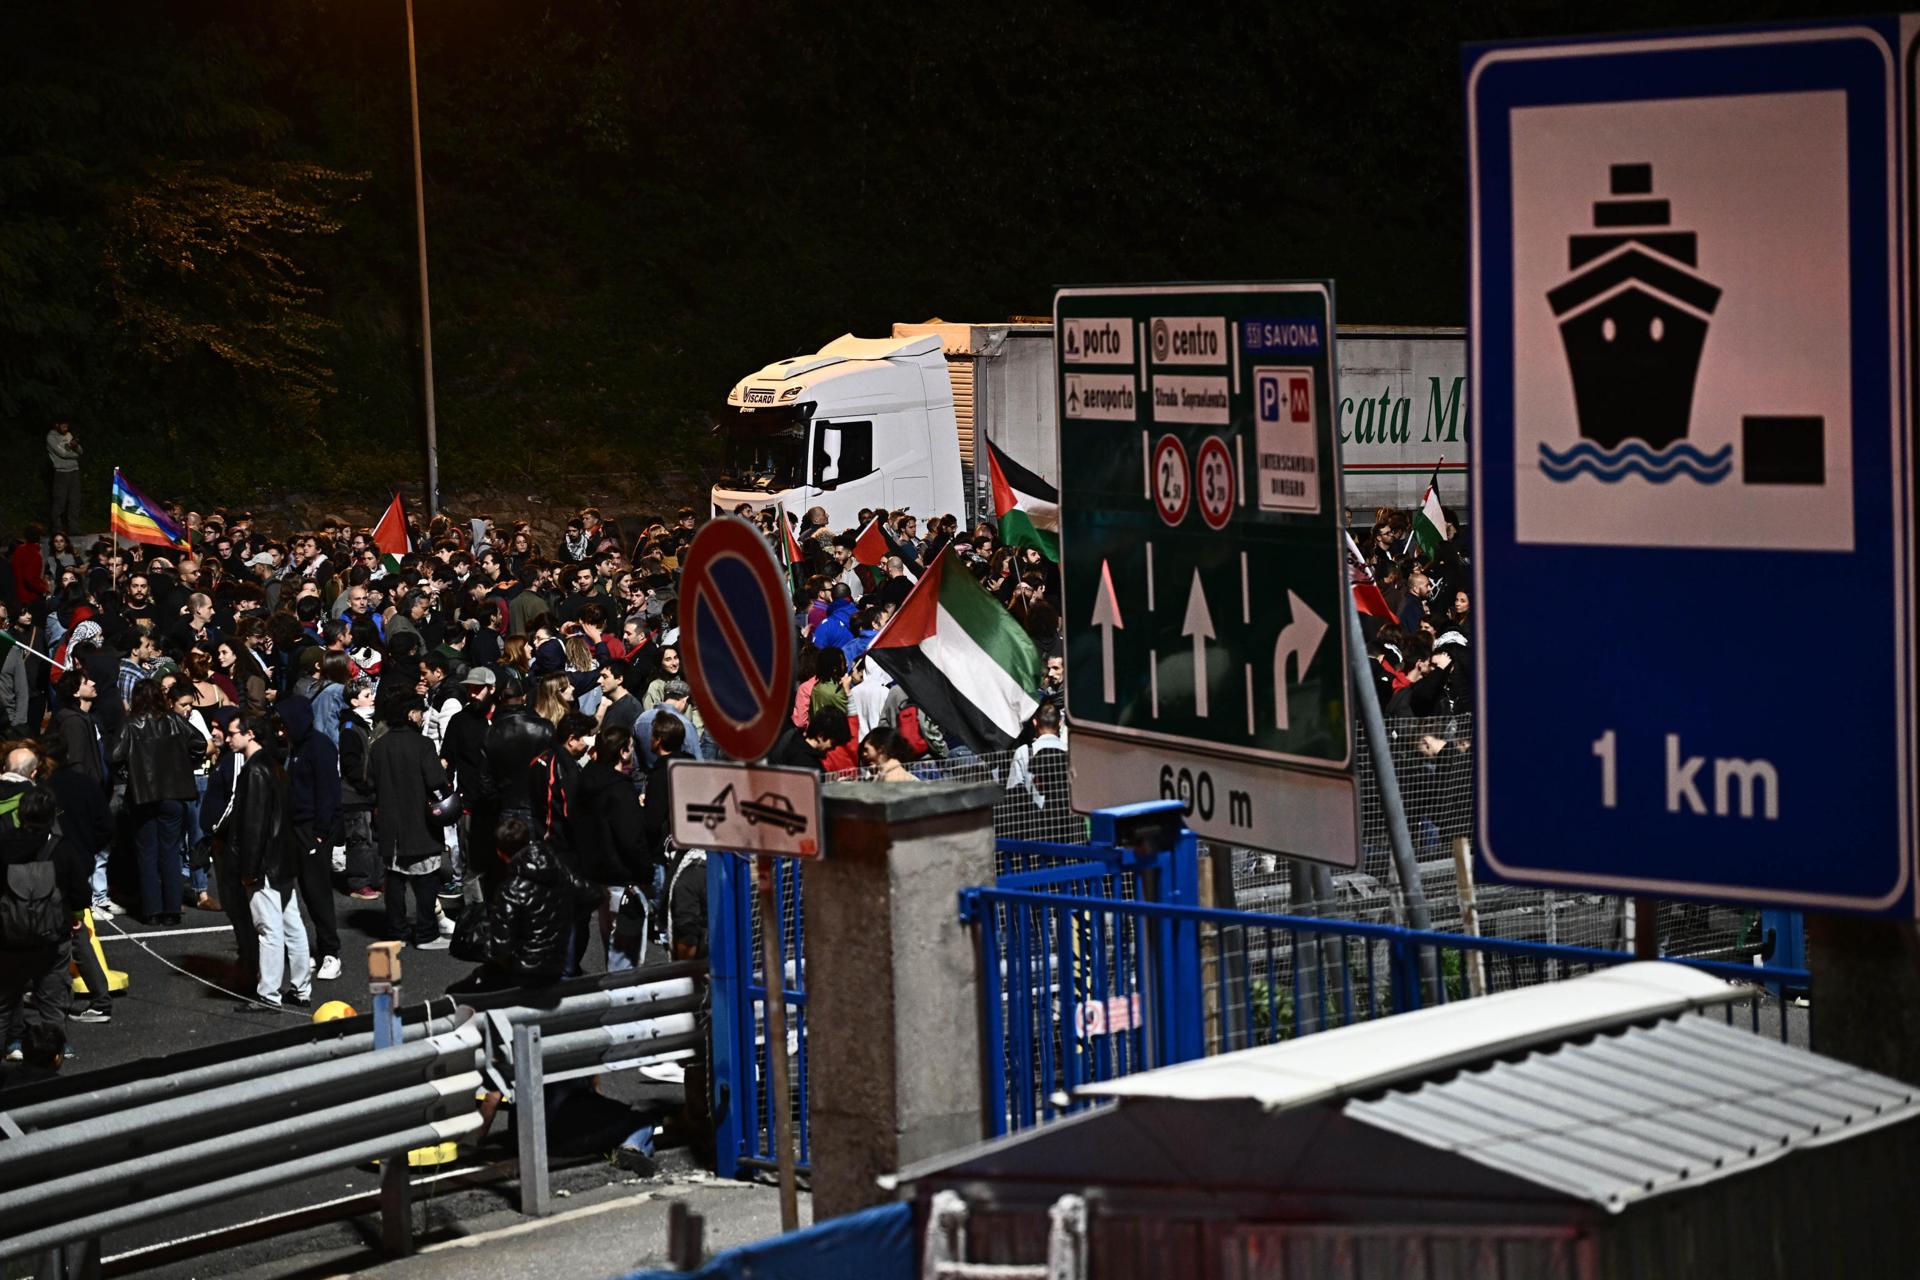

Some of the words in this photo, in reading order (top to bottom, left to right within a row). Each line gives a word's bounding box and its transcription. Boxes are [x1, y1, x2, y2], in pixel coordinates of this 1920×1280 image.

[1083, 322, 1121, 358] porto
[1173, 323, 1218, 355] centro
[1264, 324, 1319, 346] SAVONA
[743, 386, 775, 404] VISCARDI
[1083, 384, 1133, 411] aeroporto
[1155, 387, 1178, 407] Strada
[1264, 381, 1276, 417] P
[1291, 389, 1309, 413] M
[1592, 729, 1616, 808] 1
[1665, 733, 1778, 820] km
[1160, 764, 1215, 822] 600
[1229, 790, 1253, 829] m
